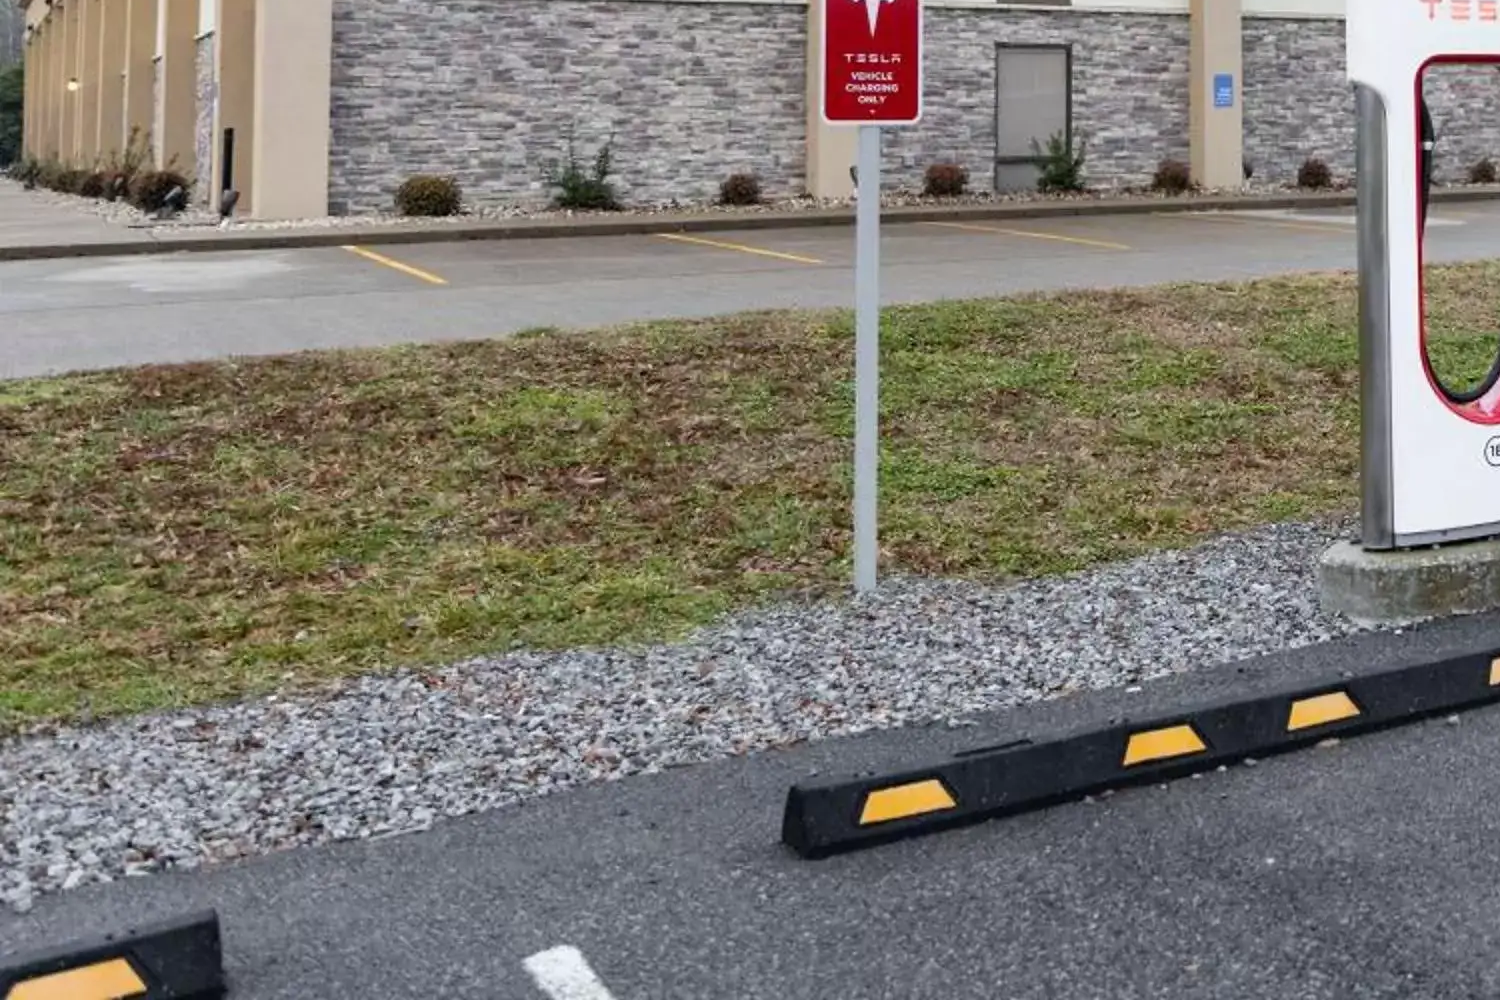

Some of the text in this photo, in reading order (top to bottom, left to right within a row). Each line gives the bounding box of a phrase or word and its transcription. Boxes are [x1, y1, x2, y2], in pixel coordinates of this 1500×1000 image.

[844, 53, 901, 63] TESLA
[851, 71, 893, 80] VEHICLE
[845, 84, 899, 92] CHARGING
[857, 96, 887, 104] ONLY
